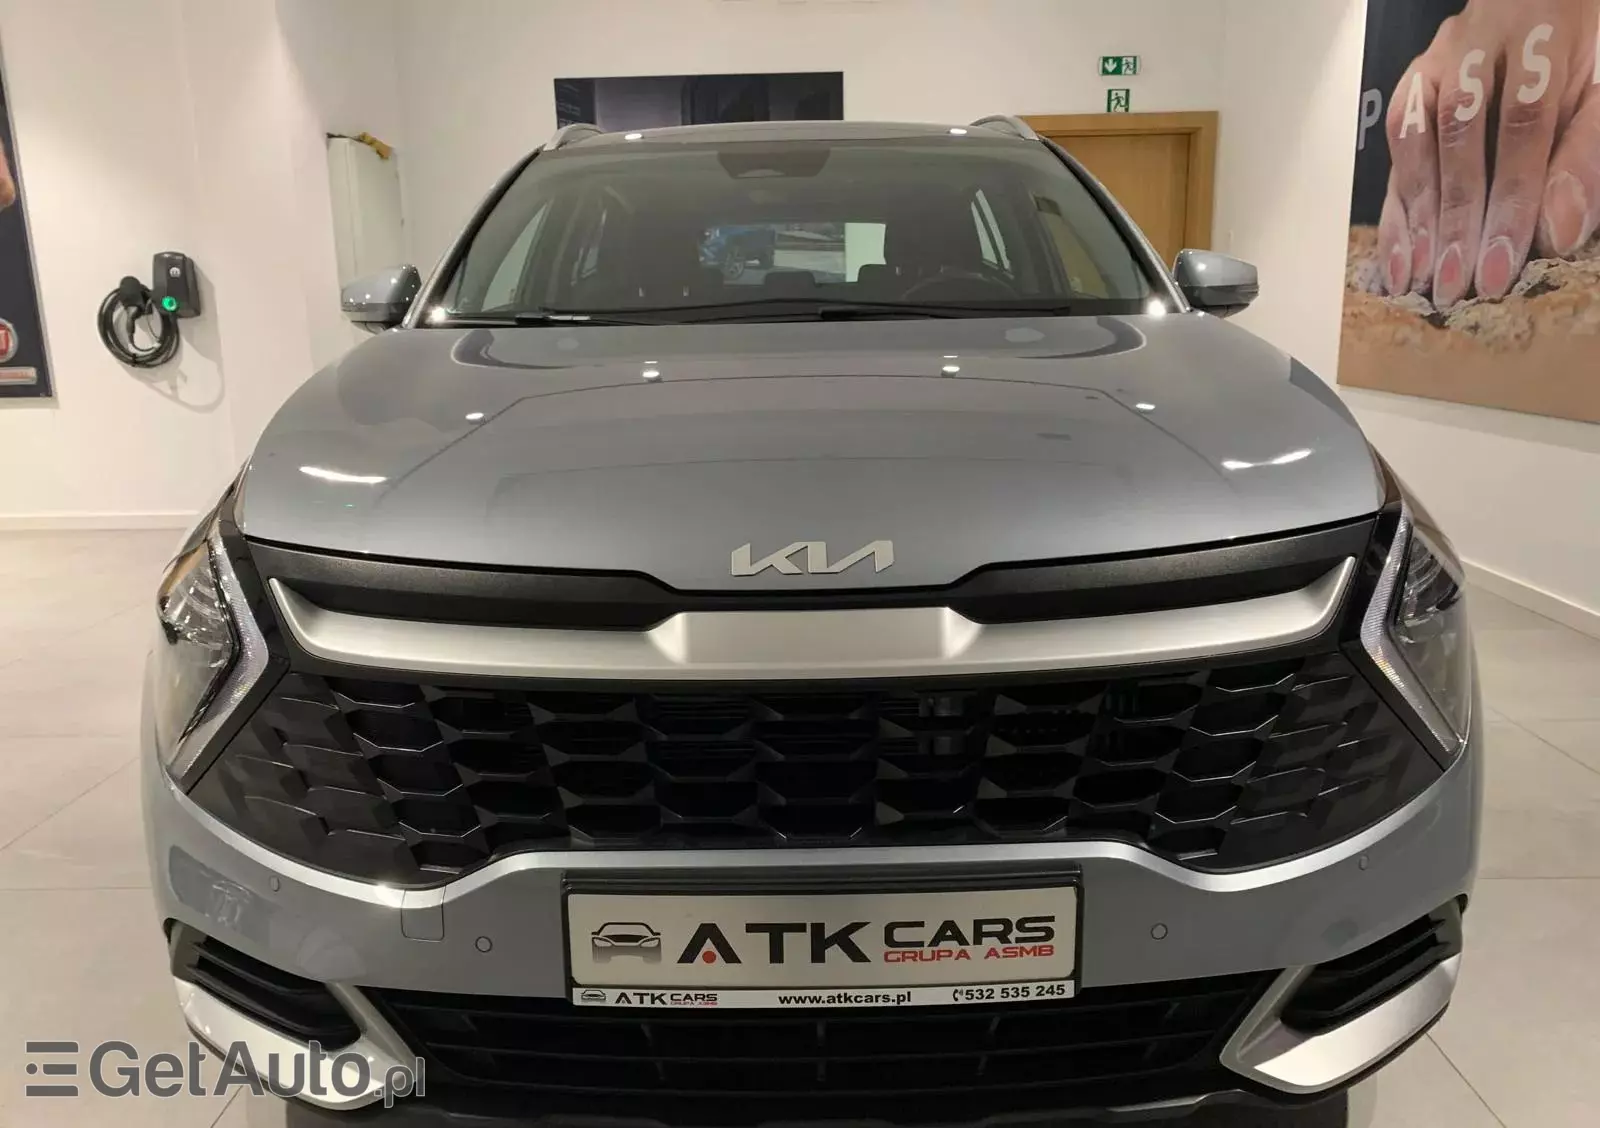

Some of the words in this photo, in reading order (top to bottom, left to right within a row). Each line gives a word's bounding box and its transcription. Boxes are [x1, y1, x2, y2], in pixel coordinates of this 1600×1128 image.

[677, 921, 871, 964] ATK
[884, 915, 1056, 948] CARS
[884, 948, 971, 963] GRUPA
[984, 944, 1055, 960] ASMB
[615, 992, 667, 1005] ATK
[670, 993, 718, 1002] CARS
[778, 991, 911, 1005] www.atkcars.pl
[965, 988, 995, 1001] 532
[1000, 986, 1030, 999] 535
[1035, 984, 1066, 997] 245
